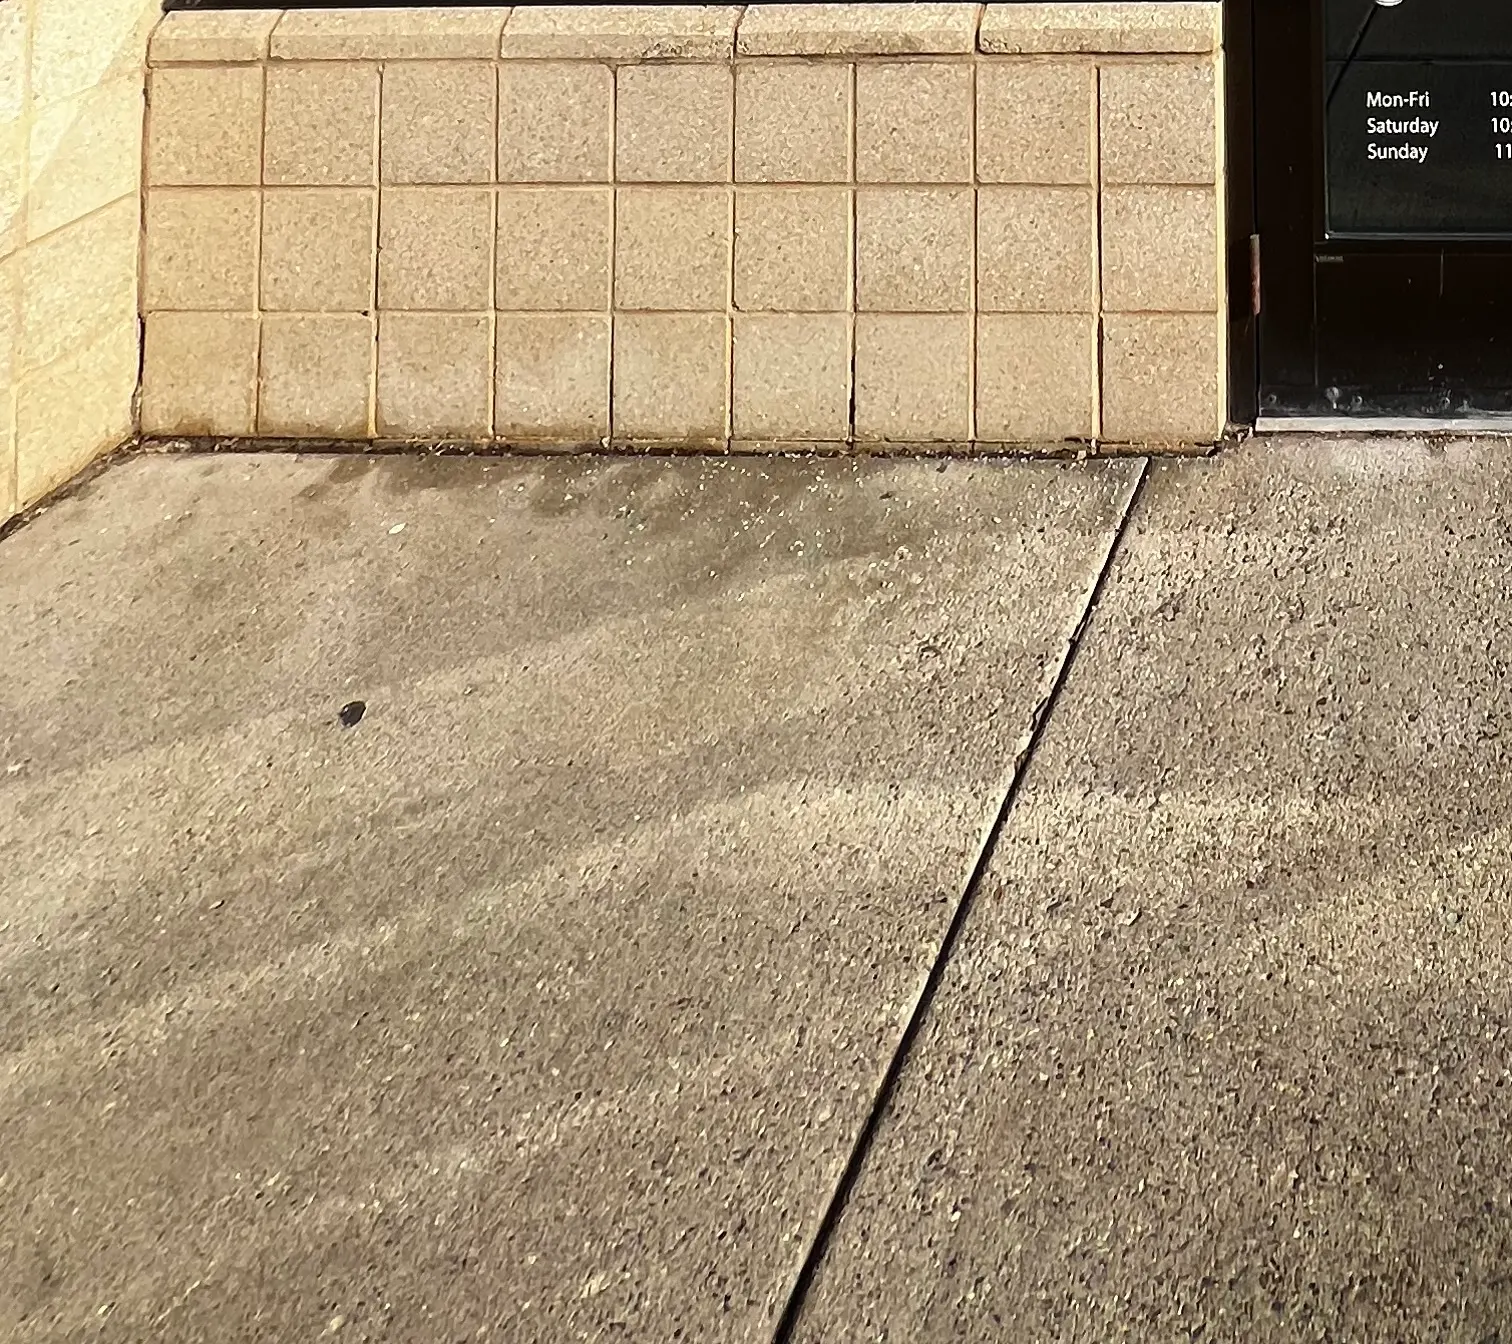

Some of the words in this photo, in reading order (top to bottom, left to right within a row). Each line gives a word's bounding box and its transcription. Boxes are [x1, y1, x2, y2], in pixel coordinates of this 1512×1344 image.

[1366, 91, 1430, 108] Mon-Fri
[1367, 117, 1439, 137] Saturday
[1367, 143, 1428, 163] Sunday
